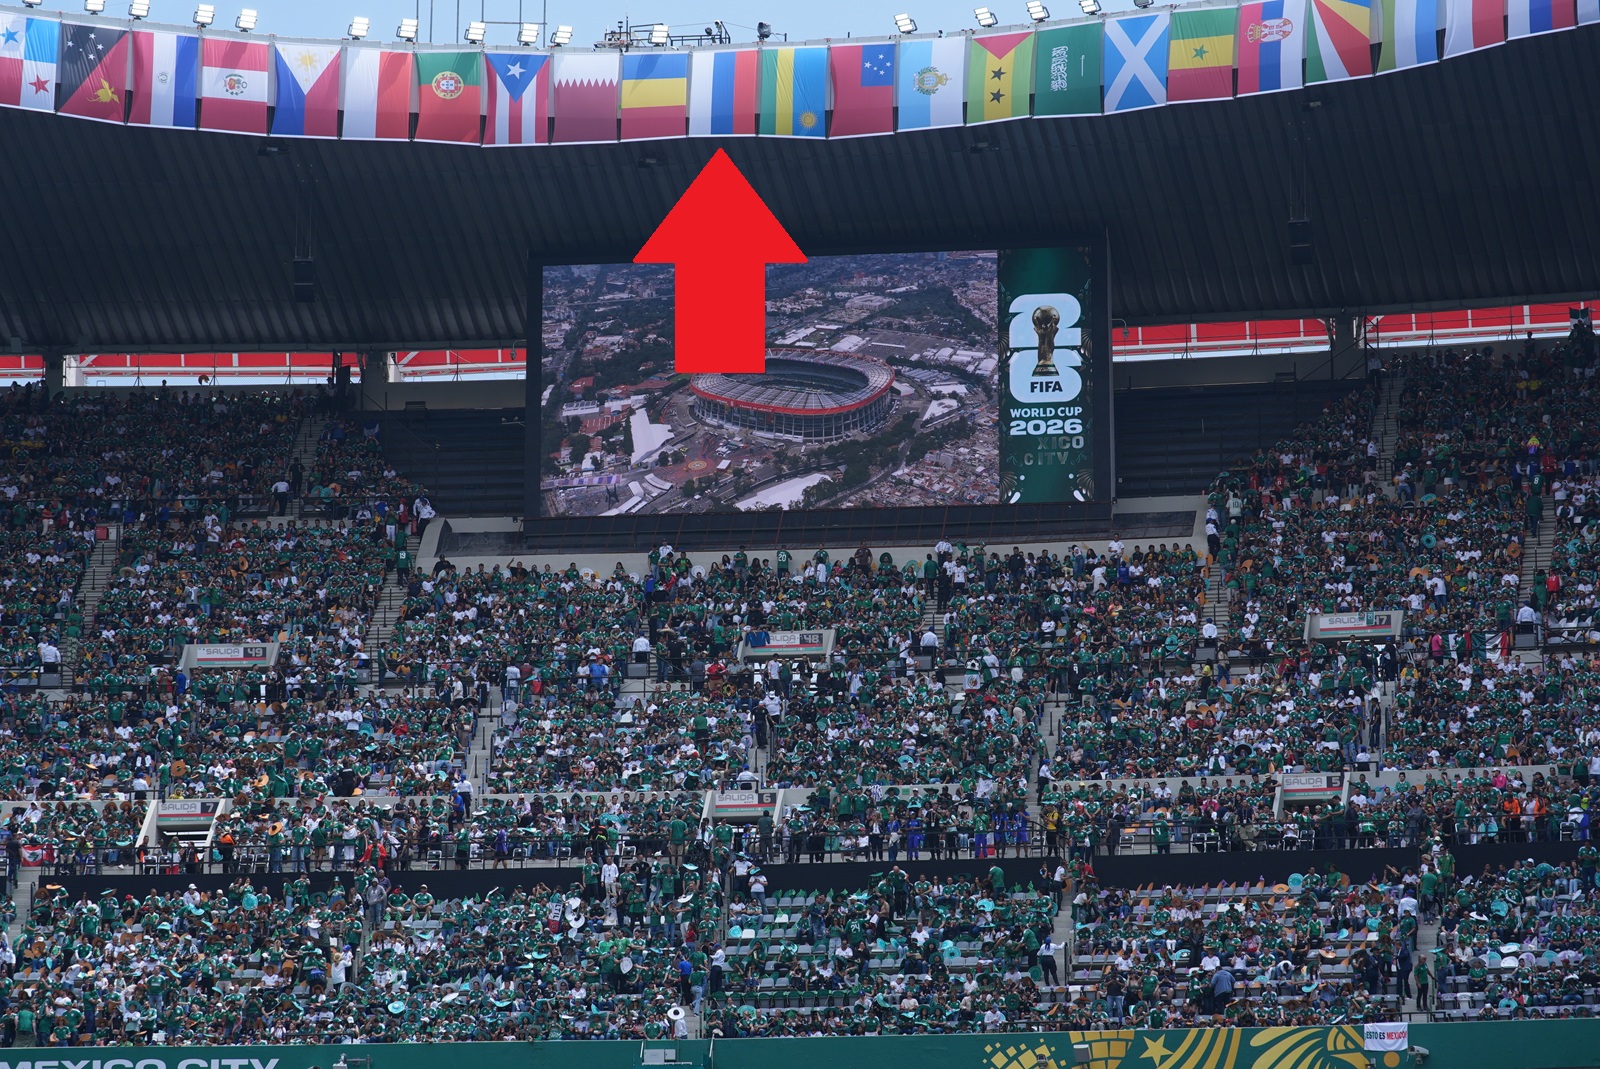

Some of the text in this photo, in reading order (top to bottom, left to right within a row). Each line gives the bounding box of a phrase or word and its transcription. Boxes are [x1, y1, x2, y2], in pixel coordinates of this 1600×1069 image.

[1030, 381, 1063, 393] FIFA
[1010, 407, 1082, 418] WORLD CUP
[1010, 418, 1083, 436] 2026
[1024, 452, 1069, 466] CITY
[778, 553, 786, 562] 20
[1328, 616, 1359, 625] SALID
[803, 634, 820, 644] 48
[247, 647, 263, 657] 49
[1285, 776, 1341, 787] SALIDA 5
[718, 793, 771, 804] SALIDA 6
[161, 803, 215, 812] SALIDA 7
[851, 923, 860, 933] 24
[1379, 1031, 1385, 1040] ES
